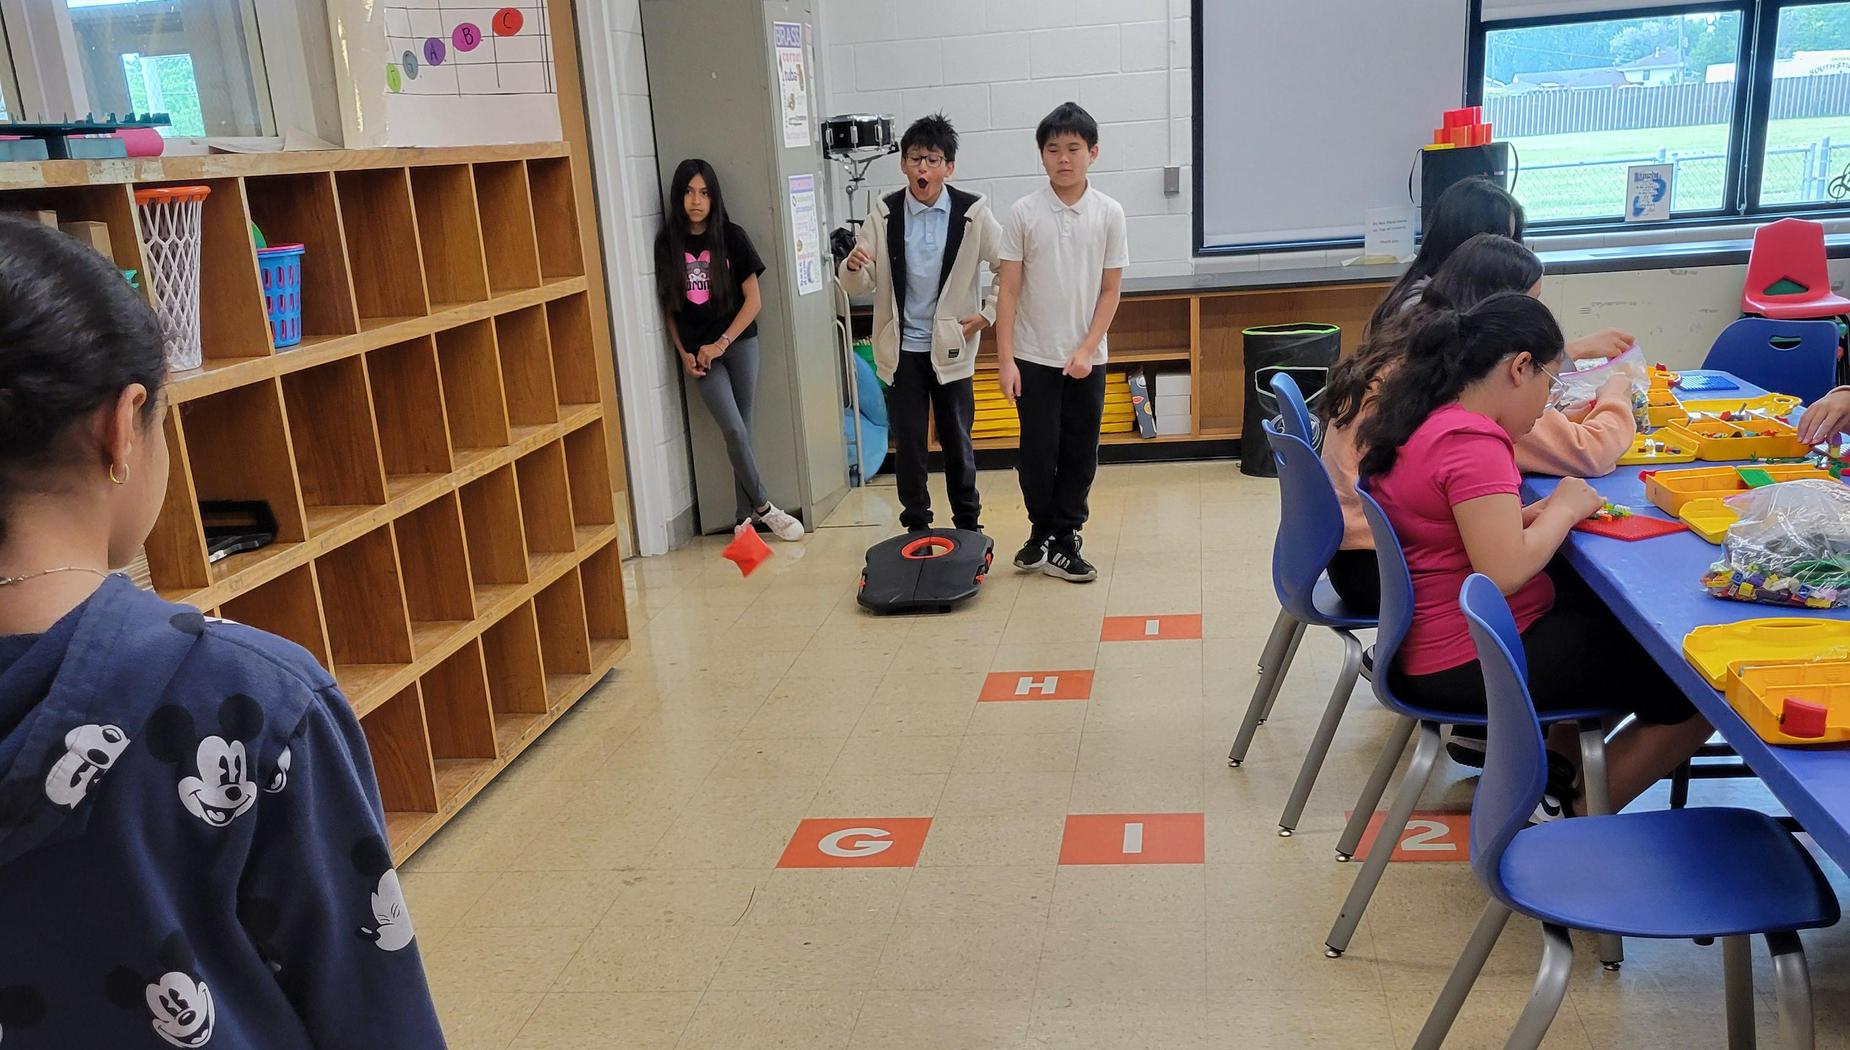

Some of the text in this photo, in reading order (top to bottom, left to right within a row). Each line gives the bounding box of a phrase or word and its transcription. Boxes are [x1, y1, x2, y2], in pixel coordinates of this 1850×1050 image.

[429, 43, 439, 61] A
[462, 27, 474, 45] B
[502, 12, 512, 29] C
[1014, 676, 1059, 695] H
[818, 827, 894, 857] G
[1400, 820, 1457, 851] 2
